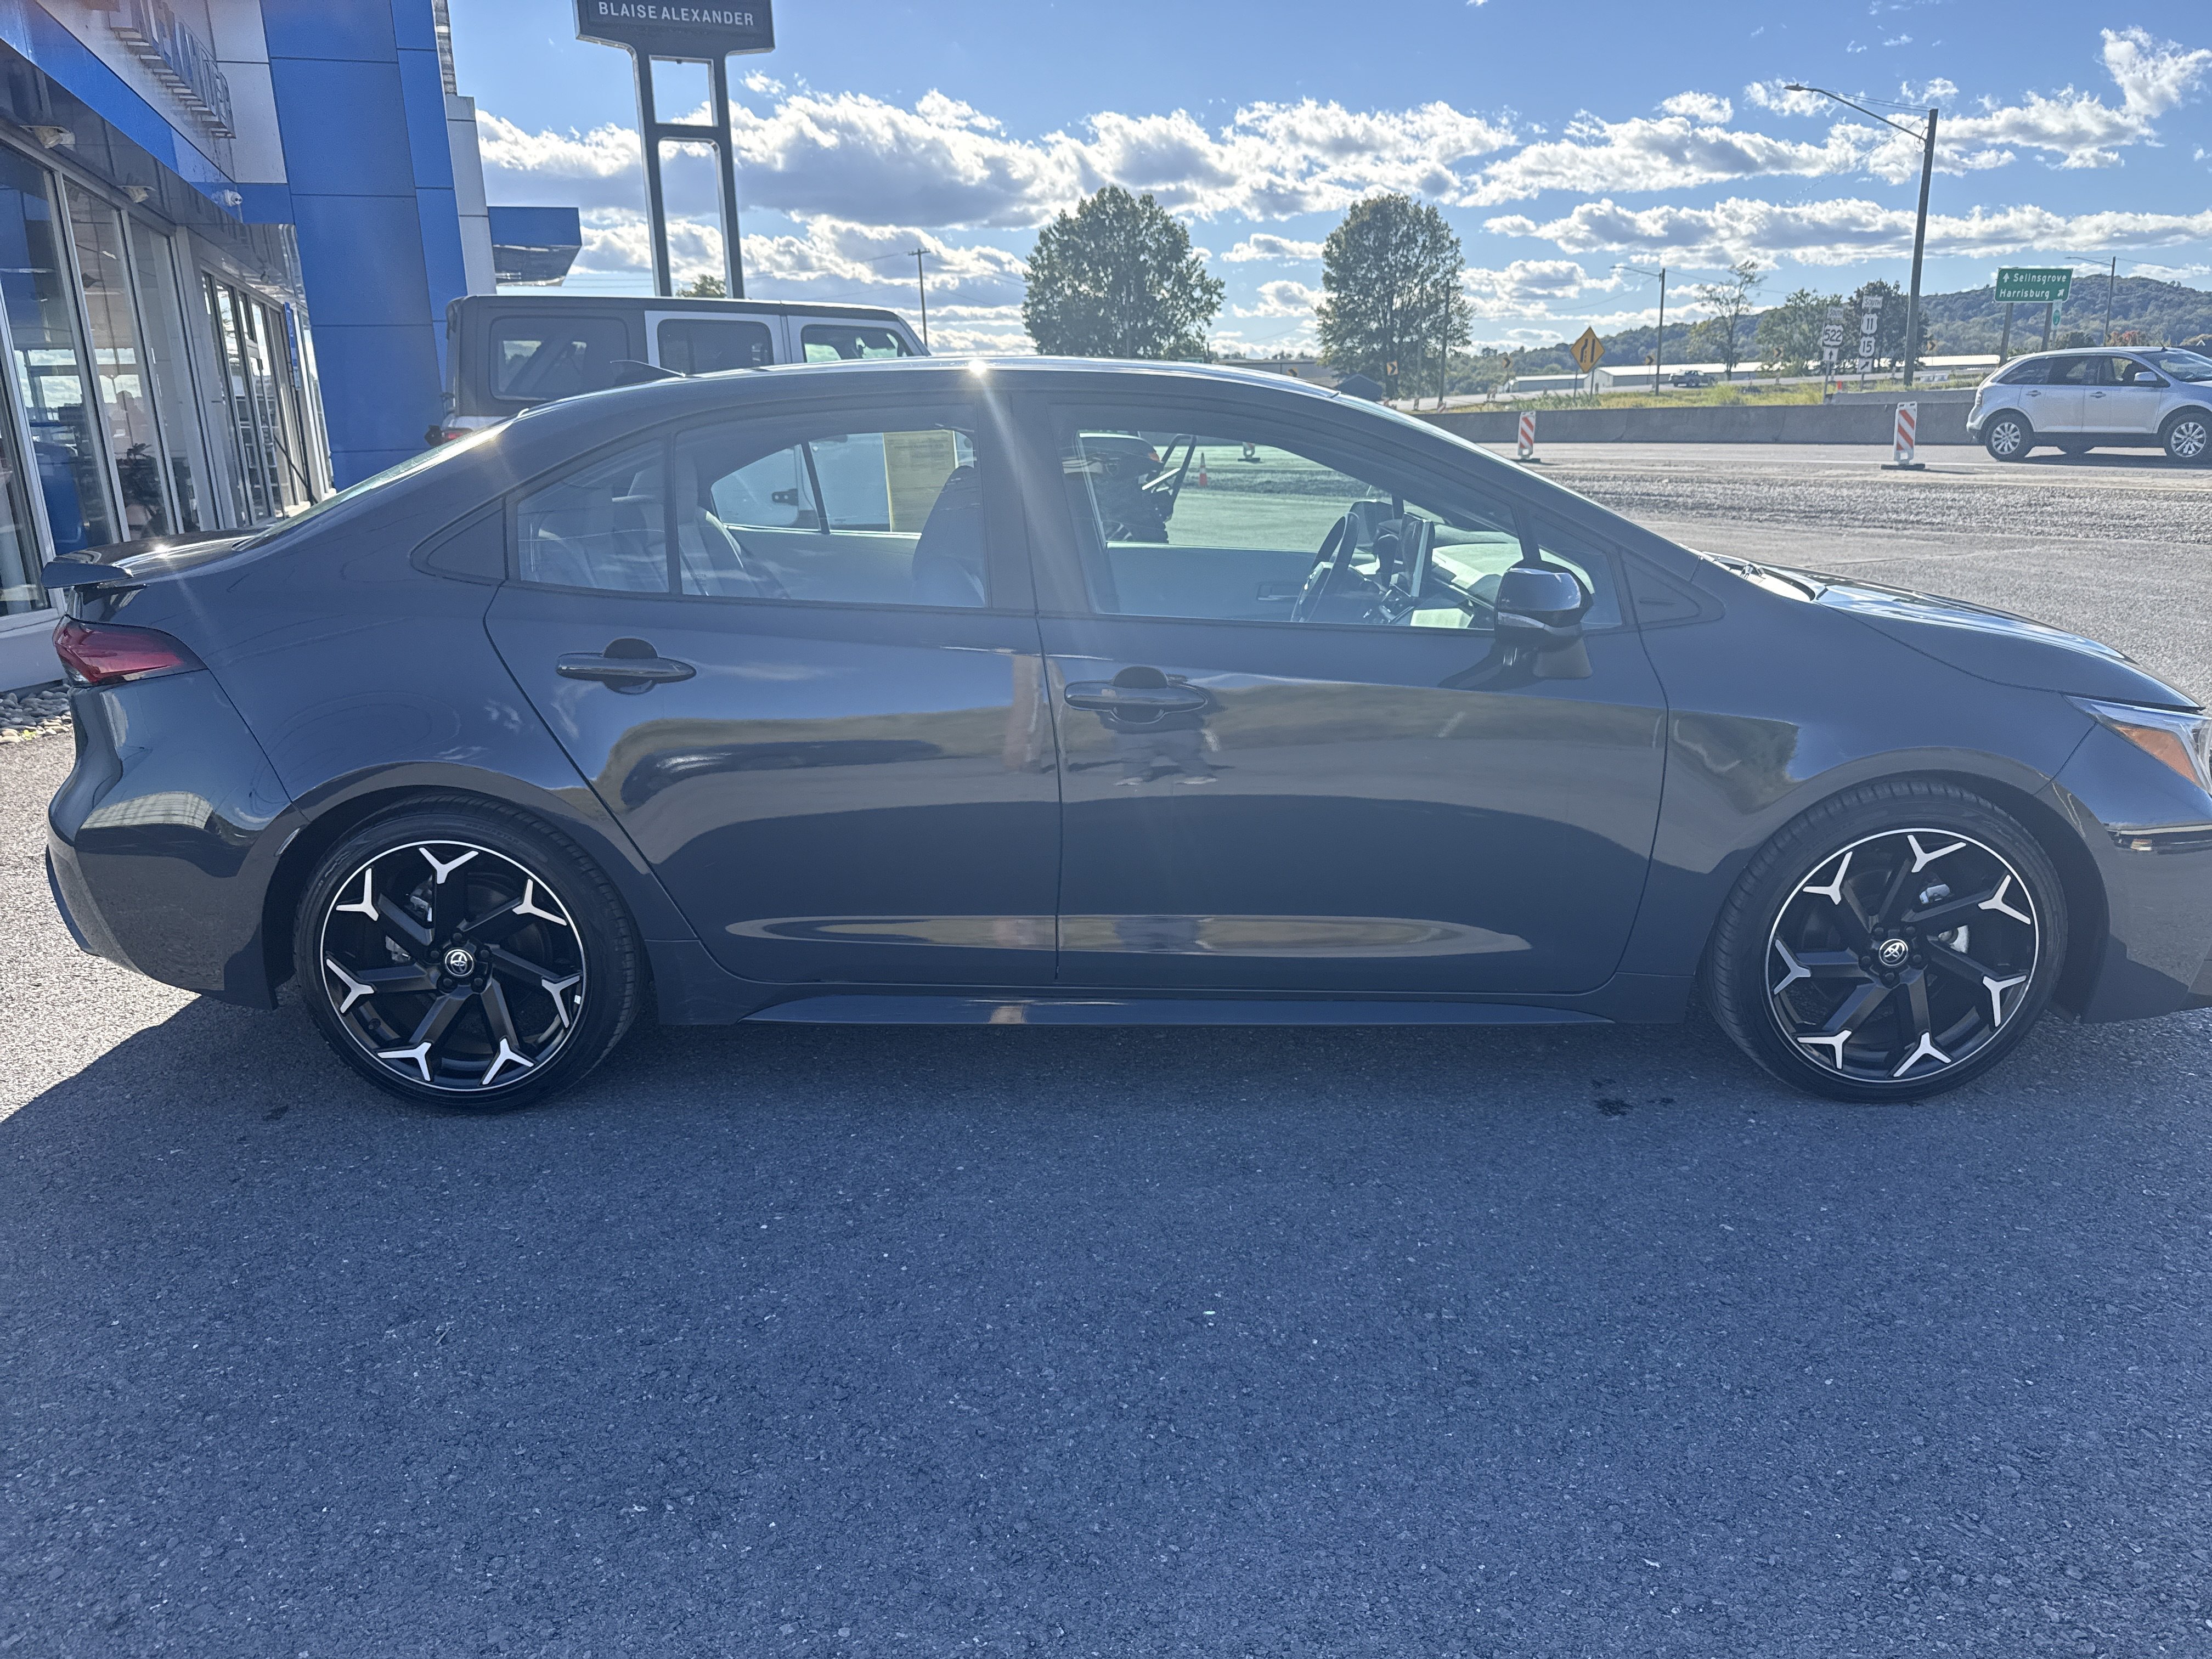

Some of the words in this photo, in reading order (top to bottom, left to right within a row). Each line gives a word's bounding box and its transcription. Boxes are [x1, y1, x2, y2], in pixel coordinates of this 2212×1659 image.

[598, 1, 657, 19] BLAISE
[661, 6, 754, 26] ALEXANDER
[2013, 273, 2067, 285] Selinsgrove
[1999, 288, 2050, 300] Harrisburg
[1866, 318, 1874, 330] 11
[1824, 329, 1842, 342] 522
[1863, 340, 1872, 353] 15
